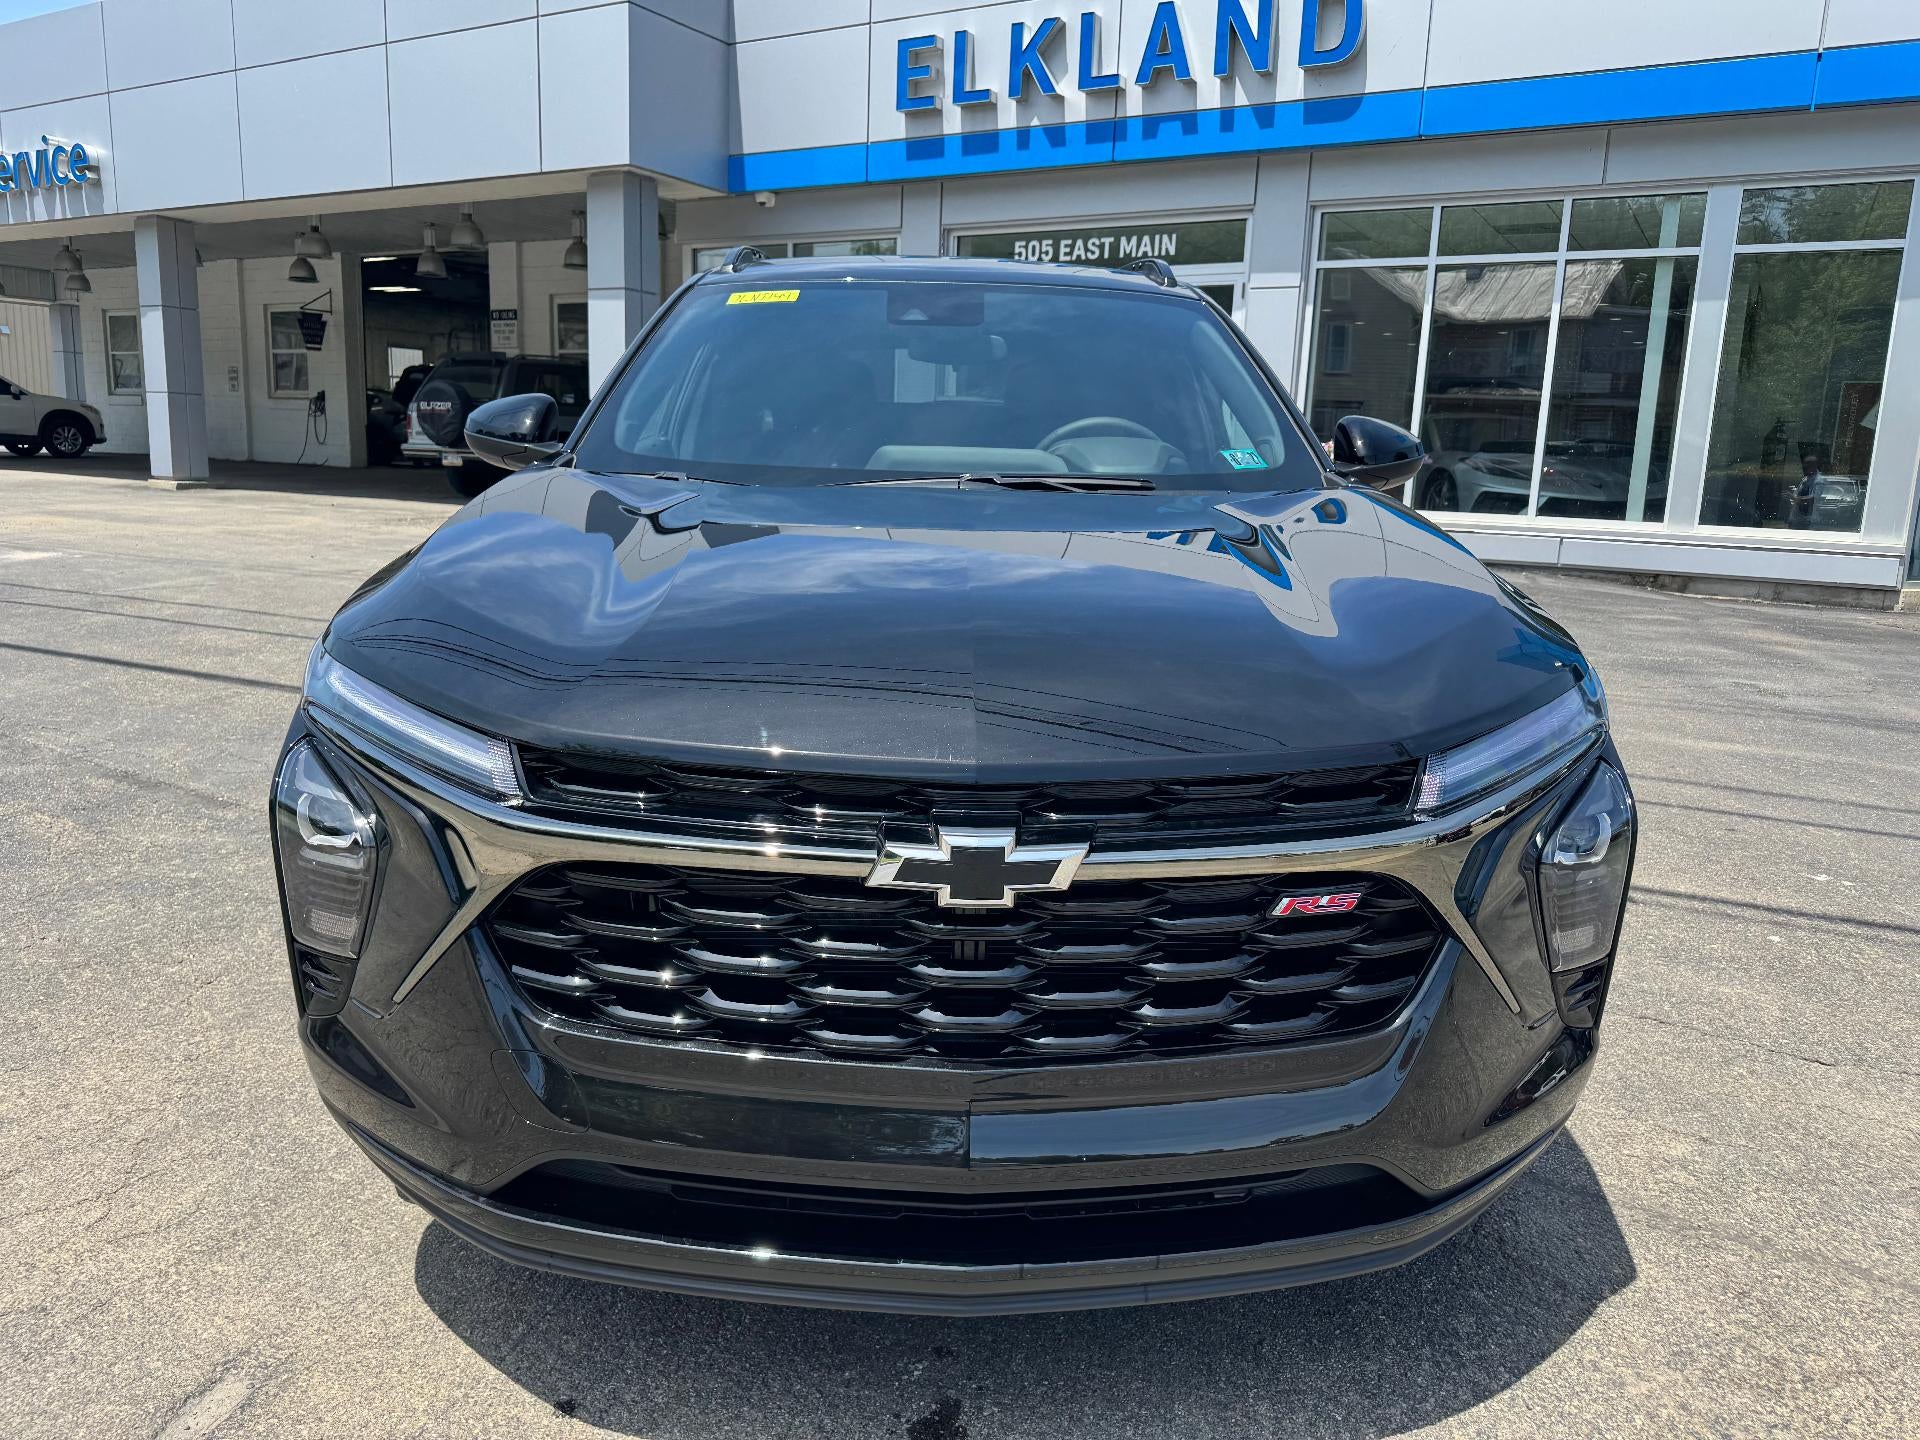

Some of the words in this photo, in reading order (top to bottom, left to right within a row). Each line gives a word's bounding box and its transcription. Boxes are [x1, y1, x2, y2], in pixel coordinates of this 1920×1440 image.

[896, 0, 1367, 113] ELKLAND
[1014, 239, 1053, 262] 505
[1059, 237, 1115, 262] EAST
[1119, 233, 1177, 259] MAIN
[1271, 892, 1362, 916] RS
